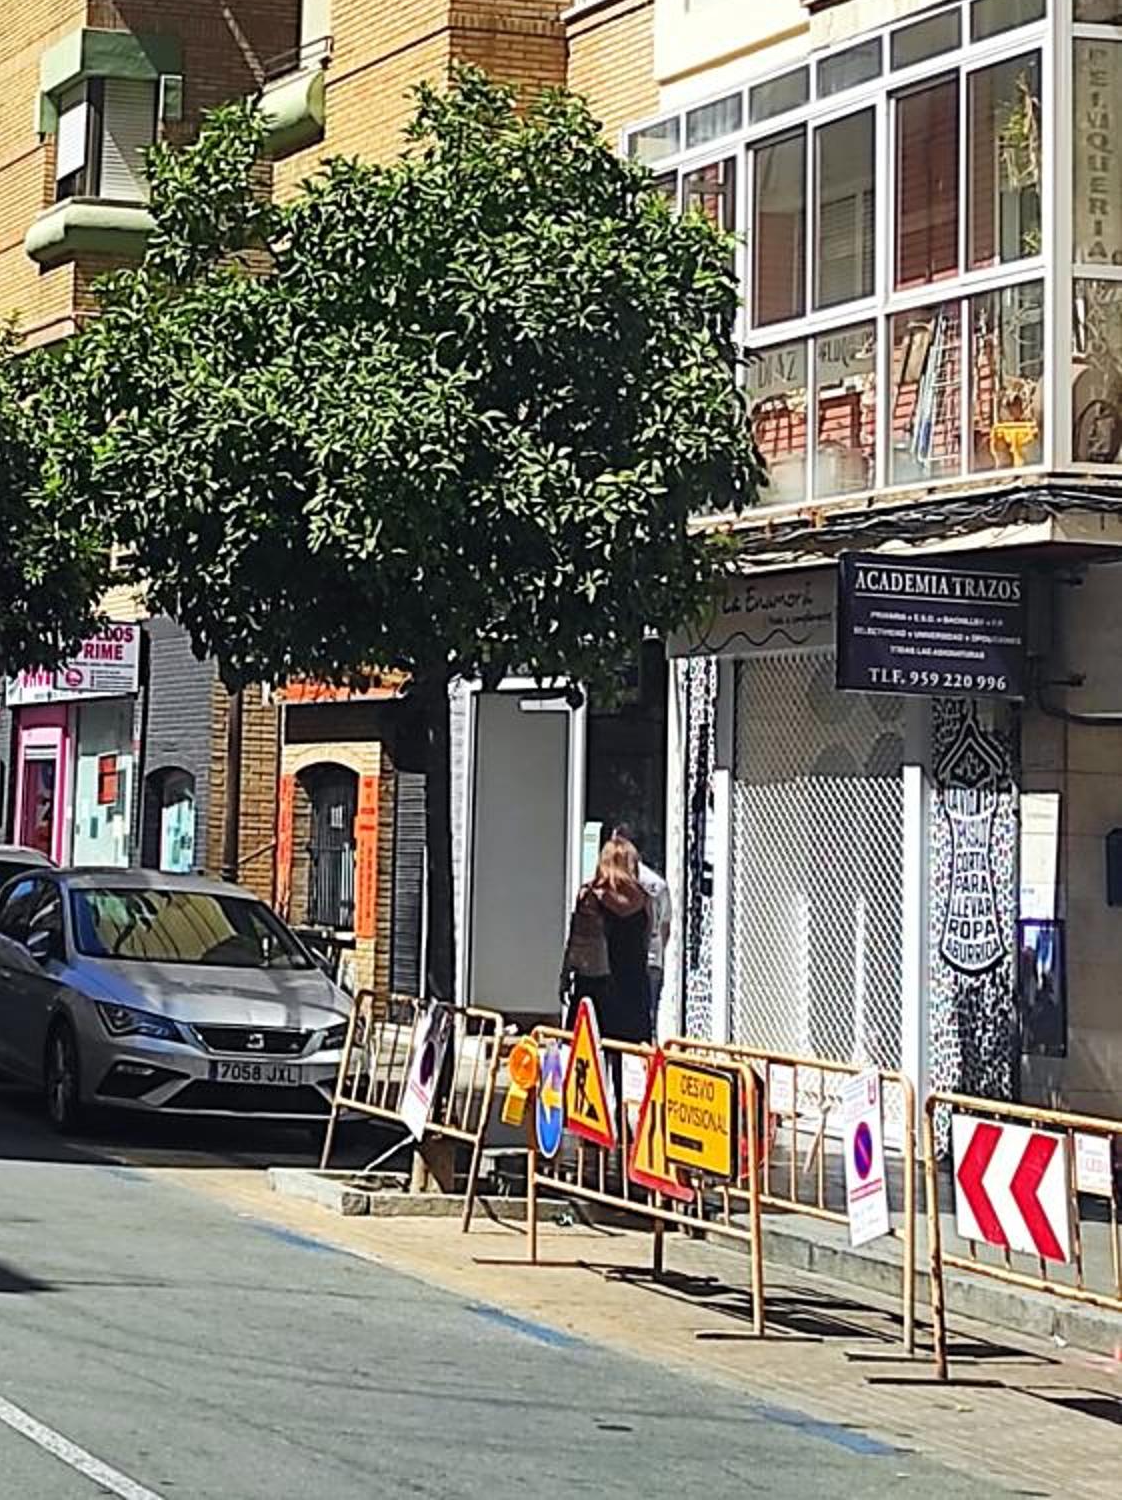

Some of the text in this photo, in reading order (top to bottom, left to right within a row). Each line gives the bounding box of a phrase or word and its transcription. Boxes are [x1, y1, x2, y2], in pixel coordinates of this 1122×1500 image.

[855, 569, 1021, 600] ACADEMIA TRAZOS
[868, 667, 1007, 690] TLF. 959 220 996
[954, 873, 990, 895] PARA
[947, 918, 997, 941] ROPA
[221, 1063, 261, 1081] 7058
[680, 1075, 715, 1102] DESVIO
